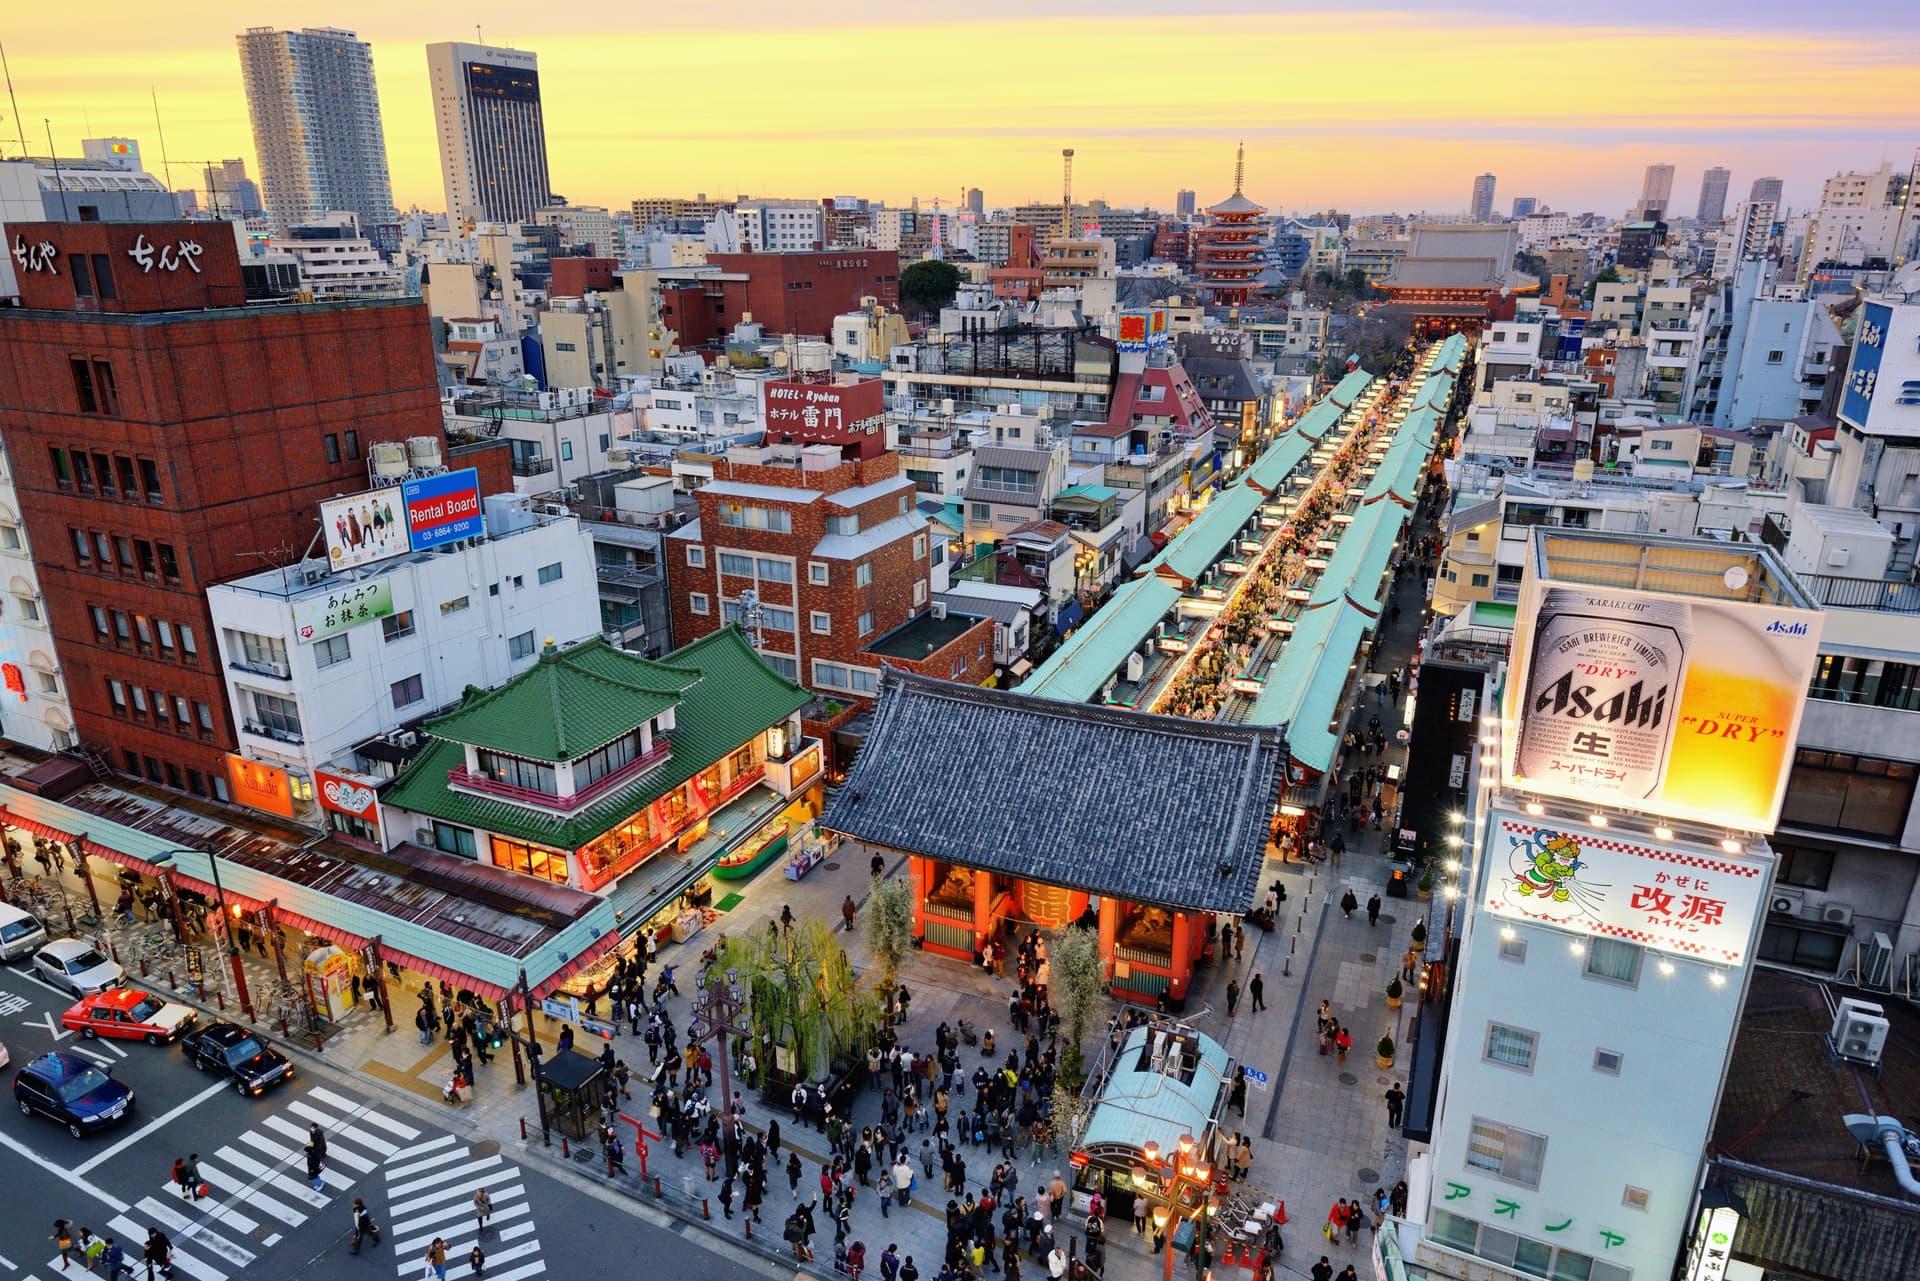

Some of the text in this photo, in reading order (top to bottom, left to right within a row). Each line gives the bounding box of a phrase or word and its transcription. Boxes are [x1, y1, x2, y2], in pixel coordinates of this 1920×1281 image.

[12, 234, 57, 274] ちんや
[128, 234, 203, 273] ちんや
[806, 390, 840, 403] Ryokan
[410, 495, 478, 524] Rental Board
[328, 584, 378, 609] あんみつ
[324, 603, 368, 628] お抹茶
[1766, 620, 1808, 636] Asahi
[1558, 637, 1580, 654] ASAHI
[1583, 632, 1632, 646] BREWERIES
[1633, 641, 1660, 668] LIMITED
[1461, 691, 1475, 719] 天ぷら
[1535, 670, 1668, 730] Asahi
[1719, 711, 1759, 724] SUPER
[1572, 731, 1611, 758] 生
[1549, 760, 1627, 782] スーパードライ
[242, 772, 279, 797] Xanadu
[1655, 871, 1710, 891] かぜに
[1630, 884, 1727, 926] 改源
[1647, 915, 1699, 933] カイゲン
[1445, 1182, 1626, 1249] アオノヤ
